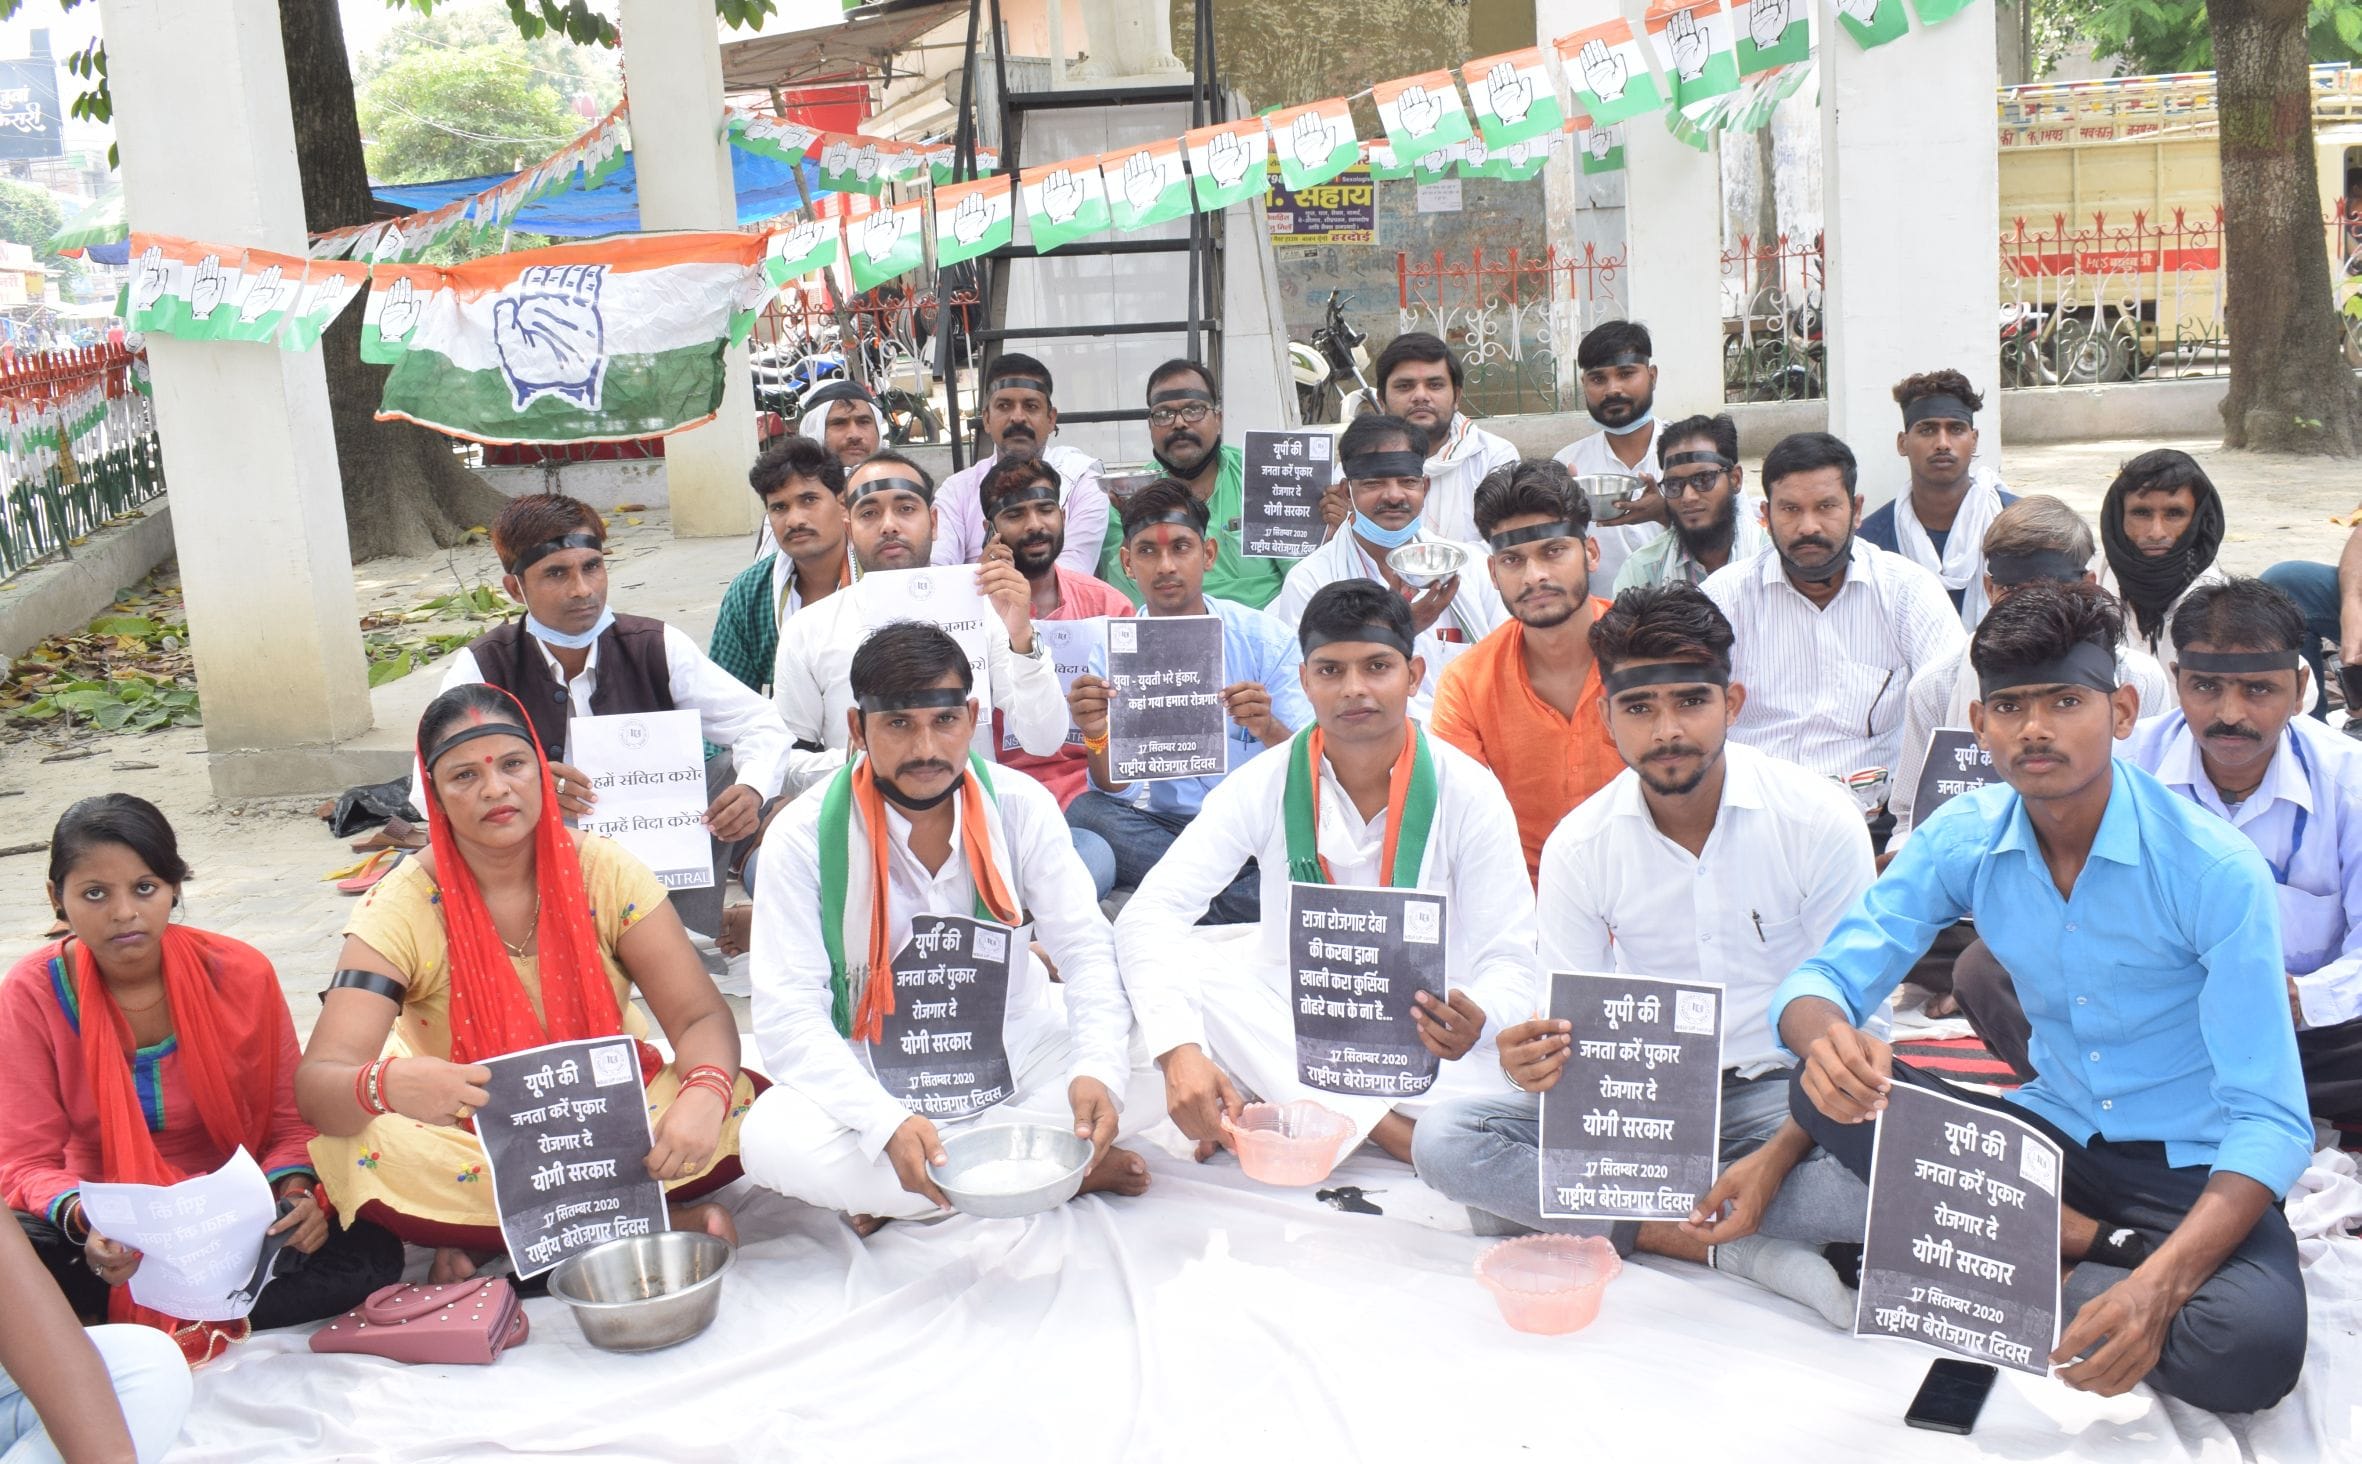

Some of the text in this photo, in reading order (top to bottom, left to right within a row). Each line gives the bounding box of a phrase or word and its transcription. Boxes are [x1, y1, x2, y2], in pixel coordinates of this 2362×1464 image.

[1294, 185, 1373, 208] सहाय
[1332, 231, 1372, 241] हरदोई
[1273, 441, 1289, 460] यूपी
[1290, 441, 1302, 456] की
[1261, 464, 1313, 480] जनता करें पुकार
[1272, 483, 1302, 497] रोजगार दे
[1264, 501, 1311, 518] योगी सरकार
[1265, 527, 1308, 538] 17 सितम्बर 2020
[1250, 539, 1270, 553] राष्ट्रीय
[1271, 540, 1301, 554] बेरोजगार
[1113, 674, 1130, 691] युवा
[1138, 671, 1161, 690] युवती
[1162, 670, 1174, 684] भरे
[1175, 669, 1200, 686] हुंकार,
[1128, 691, 1219, 710] कहां गया हमारा रोजगार
[1138, 741, 1197, 755] 17 सितम्बर 2020
[1954, 743, 1993, 771] यूपी क
[592, 772, 615, 789] हमें
[619, 770, 664, 786] संविदा
[1118, 756, 1216, 777] राष्ट्रीय बेरोजगार दिवस
[1937, 780, 1965, 794] जनता
[598, 816, 629, 838] तुम्हें
[632, 815, 664, 831] विदा
[656, 871, 711, 887] ENTRAL
[1302, 909, 1327, 929] राजा
[1327, 908, 1366, 932] रोजगार
[1368, 910, 1388, 934] देबा
[941, 928, 962, 951] की
[1308, 937, 1379, 966] की करबा ड्रामा
[897, 964, 977, 990] जनता करें पुकार
[1299, 968, 1390, 996] खाली करा कुर्सिया
[912, 998, 958, 1020] रोजगार दे
[1300, 994, 1393, 1021] तोहरे बाप के ना है...
[1603, 993, 1635, 1029] यूपी
[1637, 994, 1661, 1024] की
[901, 1029, 972, 1055] योगी सरकार
[1579, 1037, 1681, 1069] जनता करें पुकार
[1330, 1047, 1408, 1066] 17 सितम्बर 2020
[523, 1064, 554, 1098] यूपी
[555, 1060, 580, 1085] की
[909, 1072, 975, 1090] 17 सितम्बर 2020
[1307, 1064, 1433, 1092] राष्ट्रीय बेरोजगार दिवस
[1599, 1075, 1658, 1101] रोजगार दे
[510, 1097, 608, 1128] जनता करें पुकार
[924, 1094, 970, 1114] बेरोजगार
[970, 1086, 1002, 1108] दिवस
[1582, 1108, 1675, 1140] योगी सरकार
[537, 1128, 594, 1154] रोजगार दे
[1945, 1121, 2007, 1161] यूपी की
[531, 1159, 618, 1193] योगी सरकार
[1585, 1157, 1668, 1179] 17 सितम्बर 2020
[1557, 1183, 1695, 1211] राष्ट्रीय बेरोजगार दिवस
[1914, 1158, 2027, 1210] जनता करें पुकार
[543, 1197, 620, 1229] 17 सितम्बर 2020
[1934, 1202, 2000, 1241] रोजगार दे
[525, 1215, 650, 1263] राष्ट्रीय बेरोजगार दिवस
[1912, 1234, 2016, 1286] योगी सरकार
[1911, 1286, 2005, 1324] 17 सितम्बर 2020
[1875, 1306, 2033, 1365] राष्ट्रीय बेरोजगार दिवस
